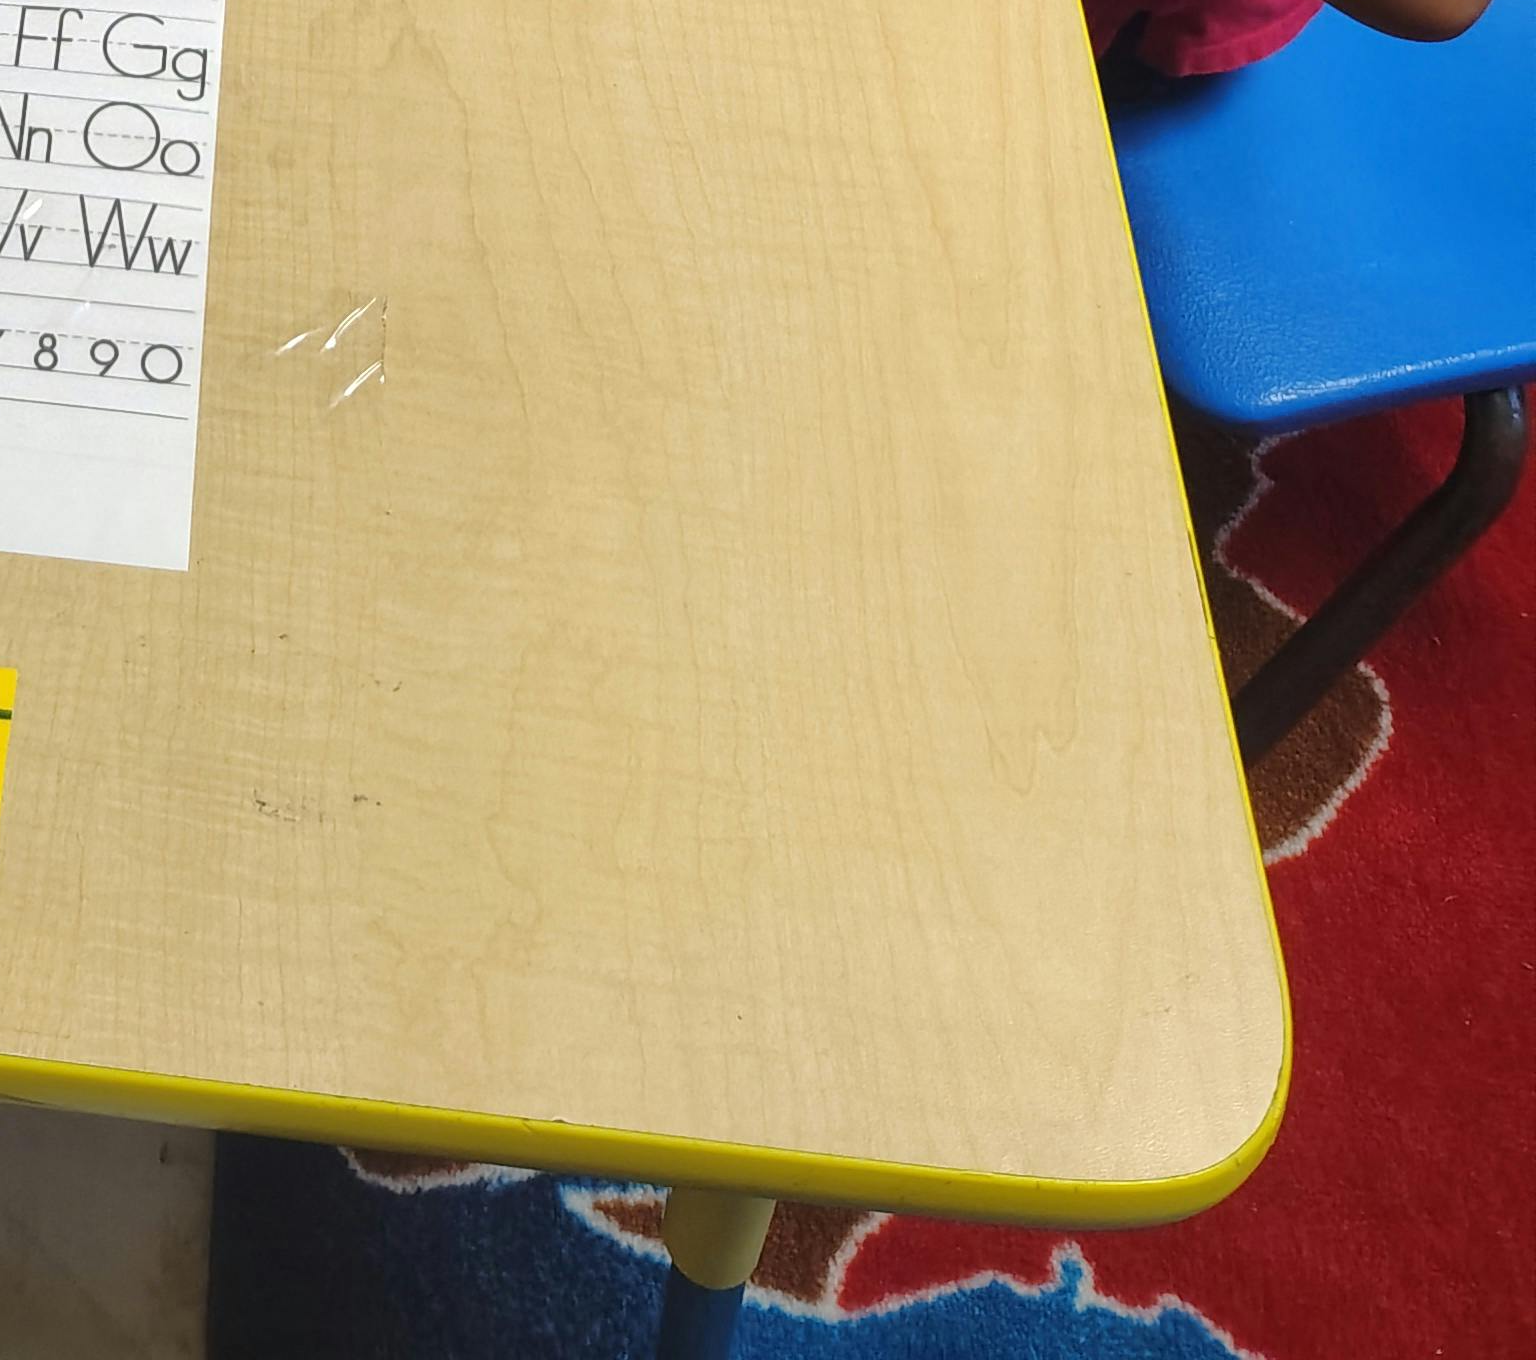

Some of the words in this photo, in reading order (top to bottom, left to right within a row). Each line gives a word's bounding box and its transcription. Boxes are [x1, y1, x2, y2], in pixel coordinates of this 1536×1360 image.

[14, 4, 82, 71] Ff
[102, 12, 210, 100] Gg
[83, 100, 202, 178] Oo
[78, 192, 192, 277] Ww
[32, 333, 60, 372] 8
[89, 339, 119, 379] 9
[139, 344, 184, 383] 0
